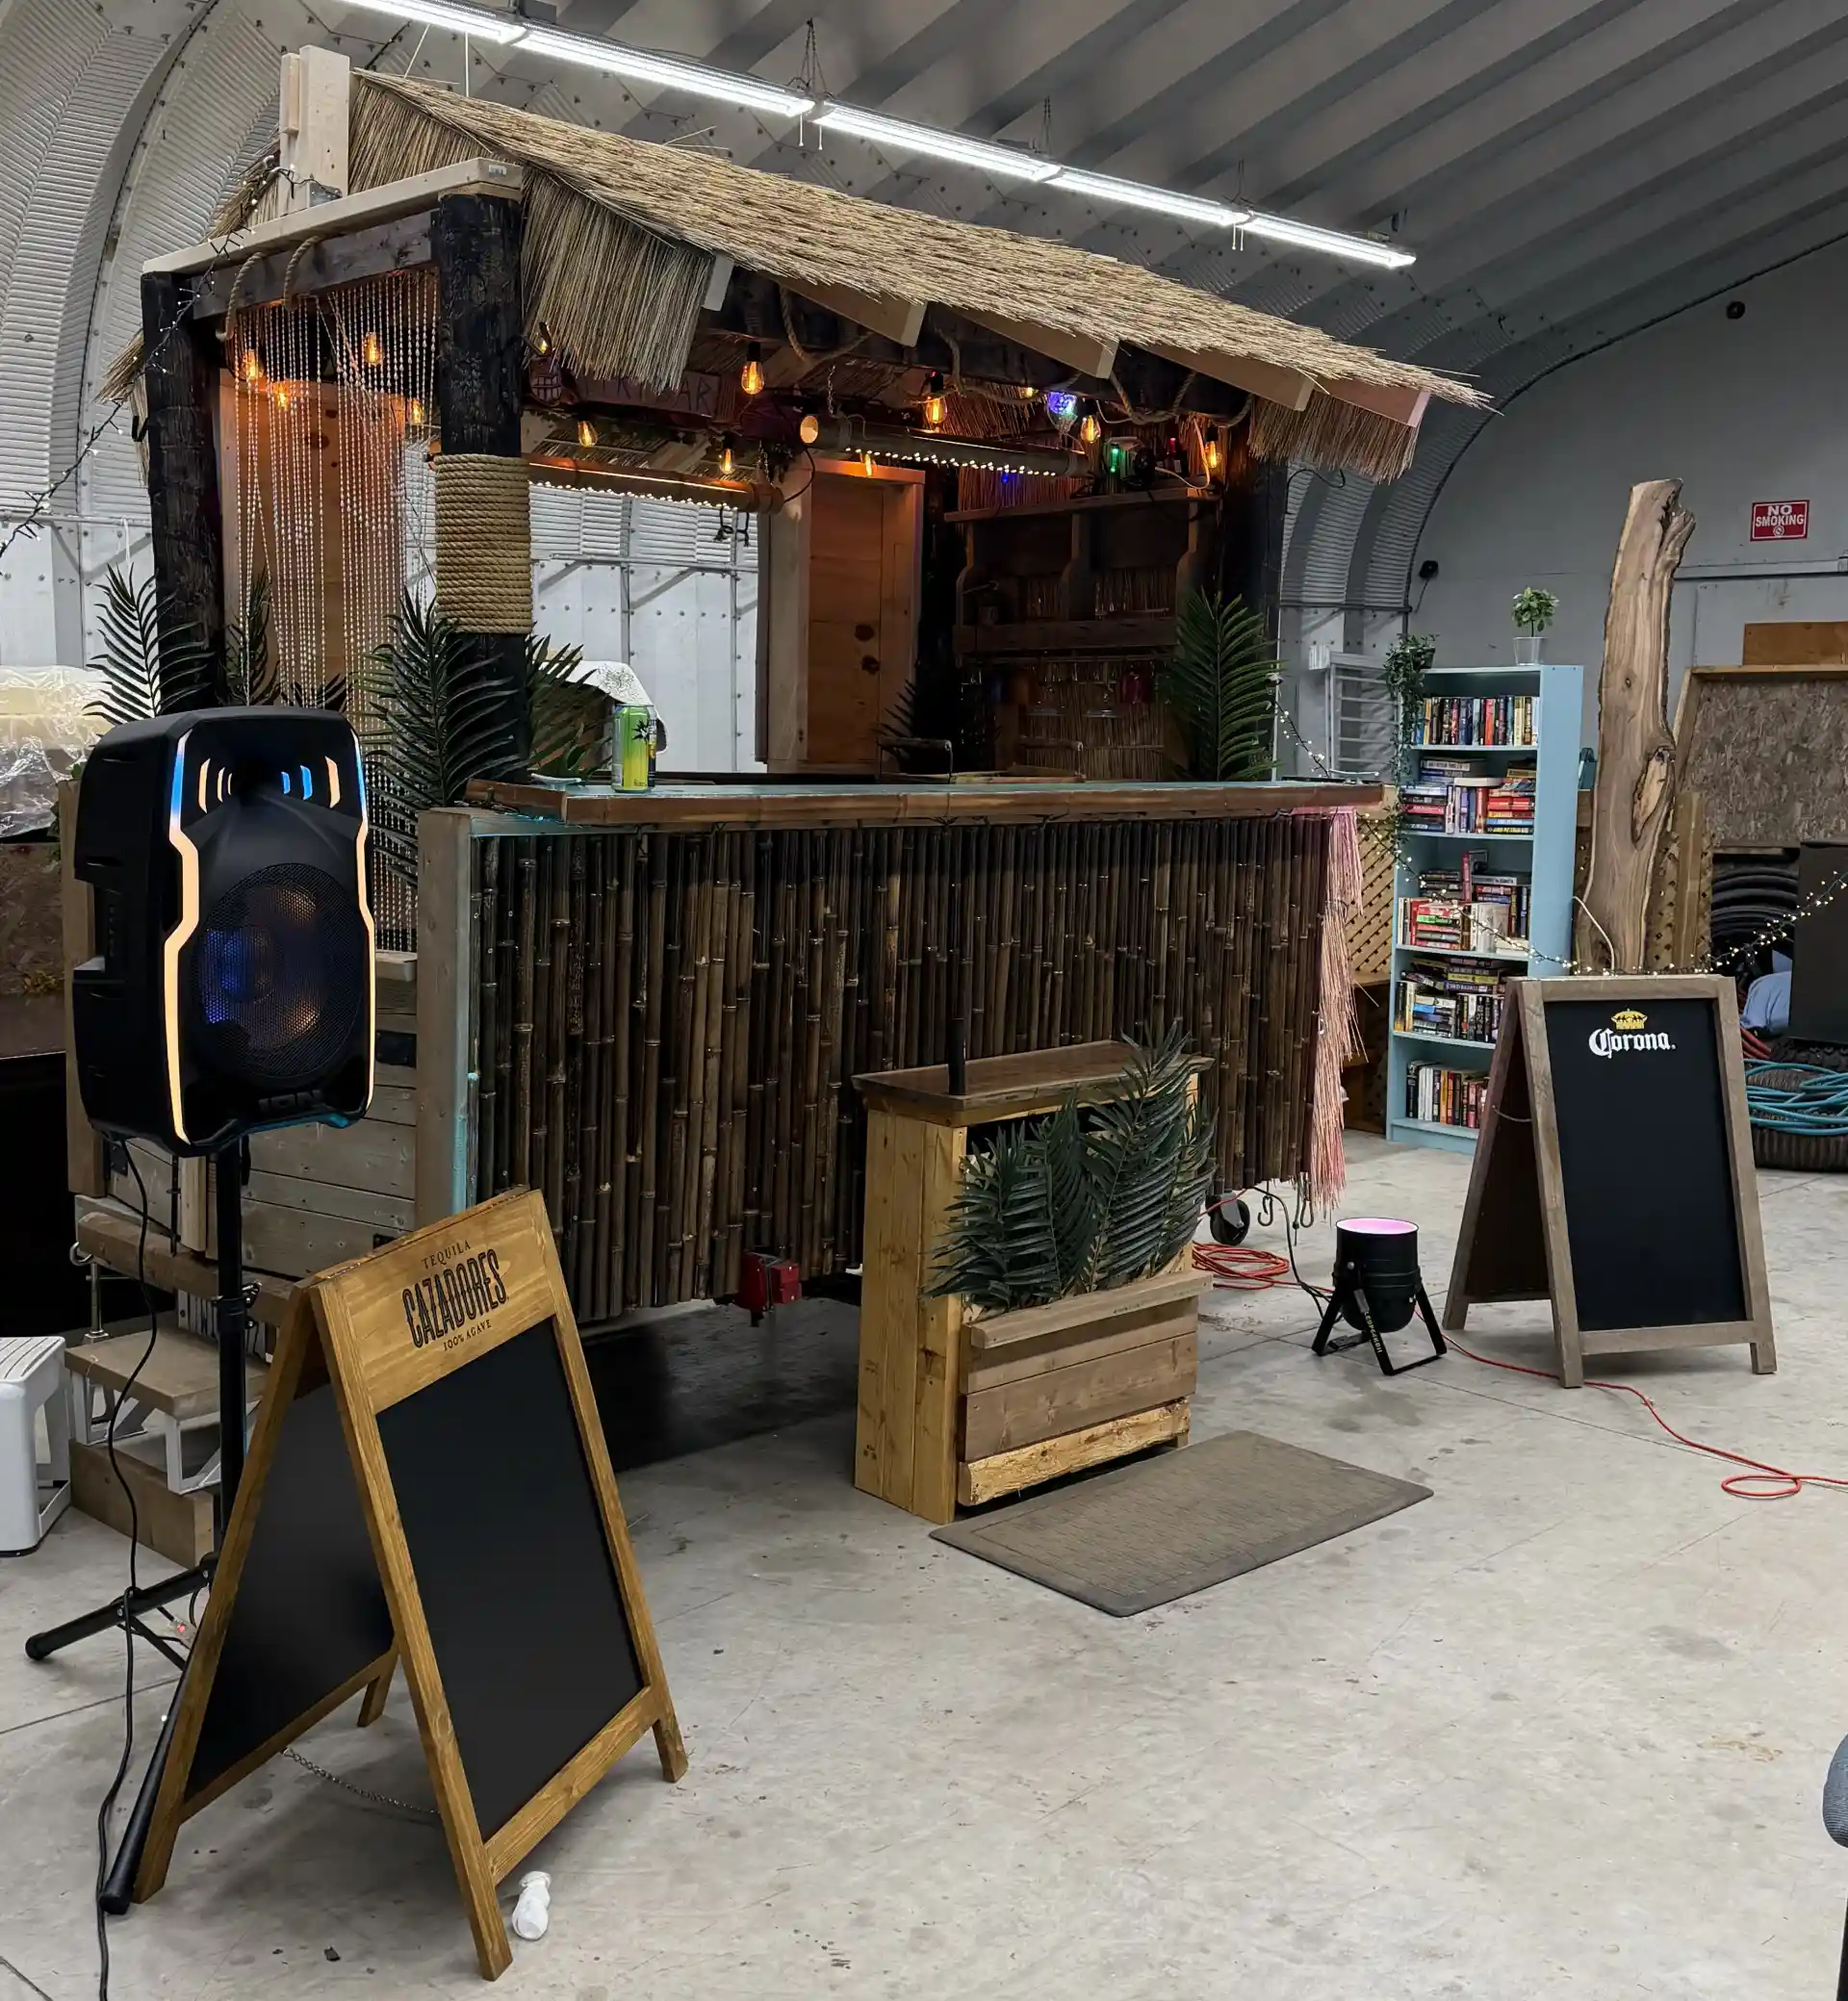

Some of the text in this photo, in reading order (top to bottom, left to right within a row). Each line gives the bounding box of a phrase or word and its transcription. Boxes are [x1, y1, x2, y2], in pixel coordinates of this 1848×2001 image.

[1756, 514, 1804, 527] SMOKING
[1767, 505, 1792, 516] NO
[422, 1240, 471, 1269] TEQUILA
[401, 1248, 507, 1348] CAZADORES
[443, 1320, 492, 1351] 100% AGAVE
